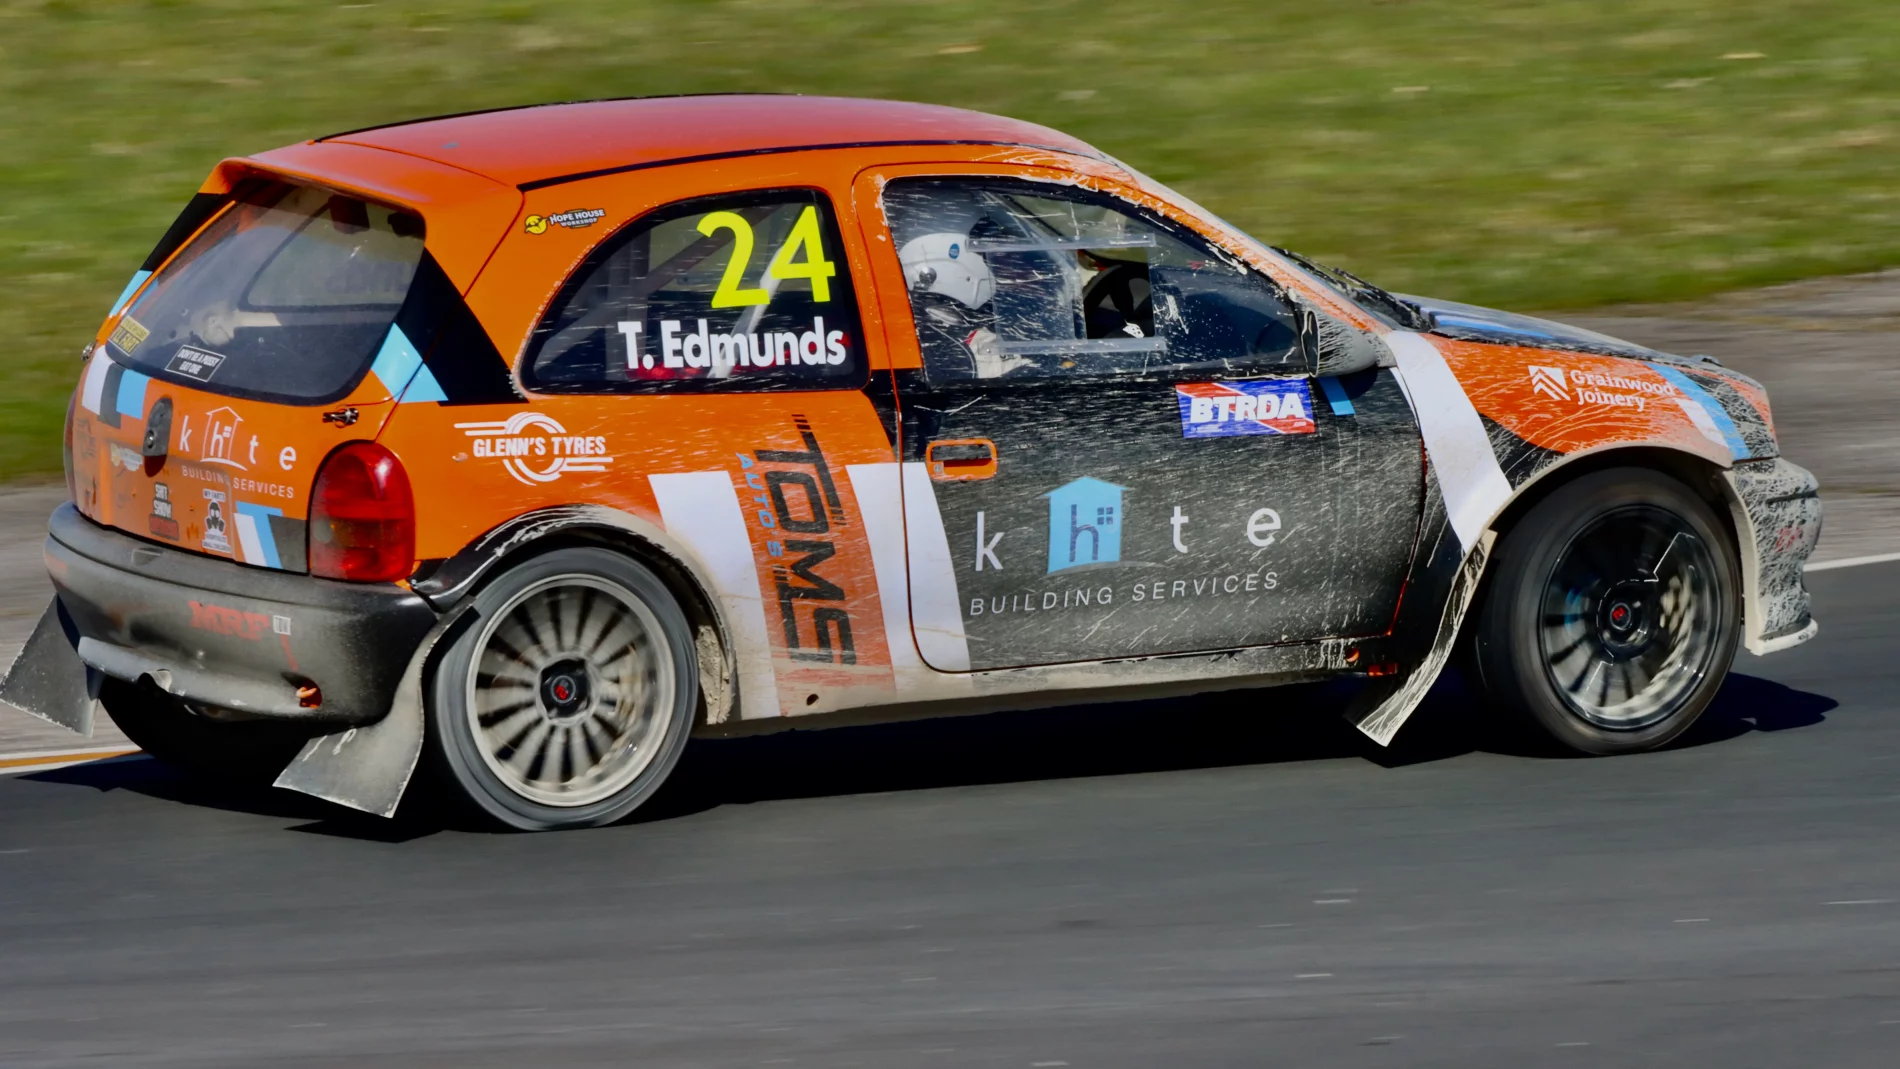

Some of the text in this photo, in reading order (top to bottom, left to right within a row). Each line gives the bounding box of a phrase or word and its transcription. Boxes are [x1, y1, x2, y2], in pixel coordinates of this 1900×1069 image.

[549, 208, 605, 226] HOPE HOUSE
[560, 217, 598, 228] WORKSHOP
[696, 205, 836, 309] 24
[617, 315, 847, 370] T. Edmunds
[1569, 369, 1676, 396] Grainwood
[1189, 391, 1307, 423] BTRDA
[1576, 387, 1646, 412] Joinery
[473, 435, 606, 457] GLENN'S TYRES
[232, 476, 295, 499] SERVICES
[969, 571, 1279, 616] BUILDING SERVICES
